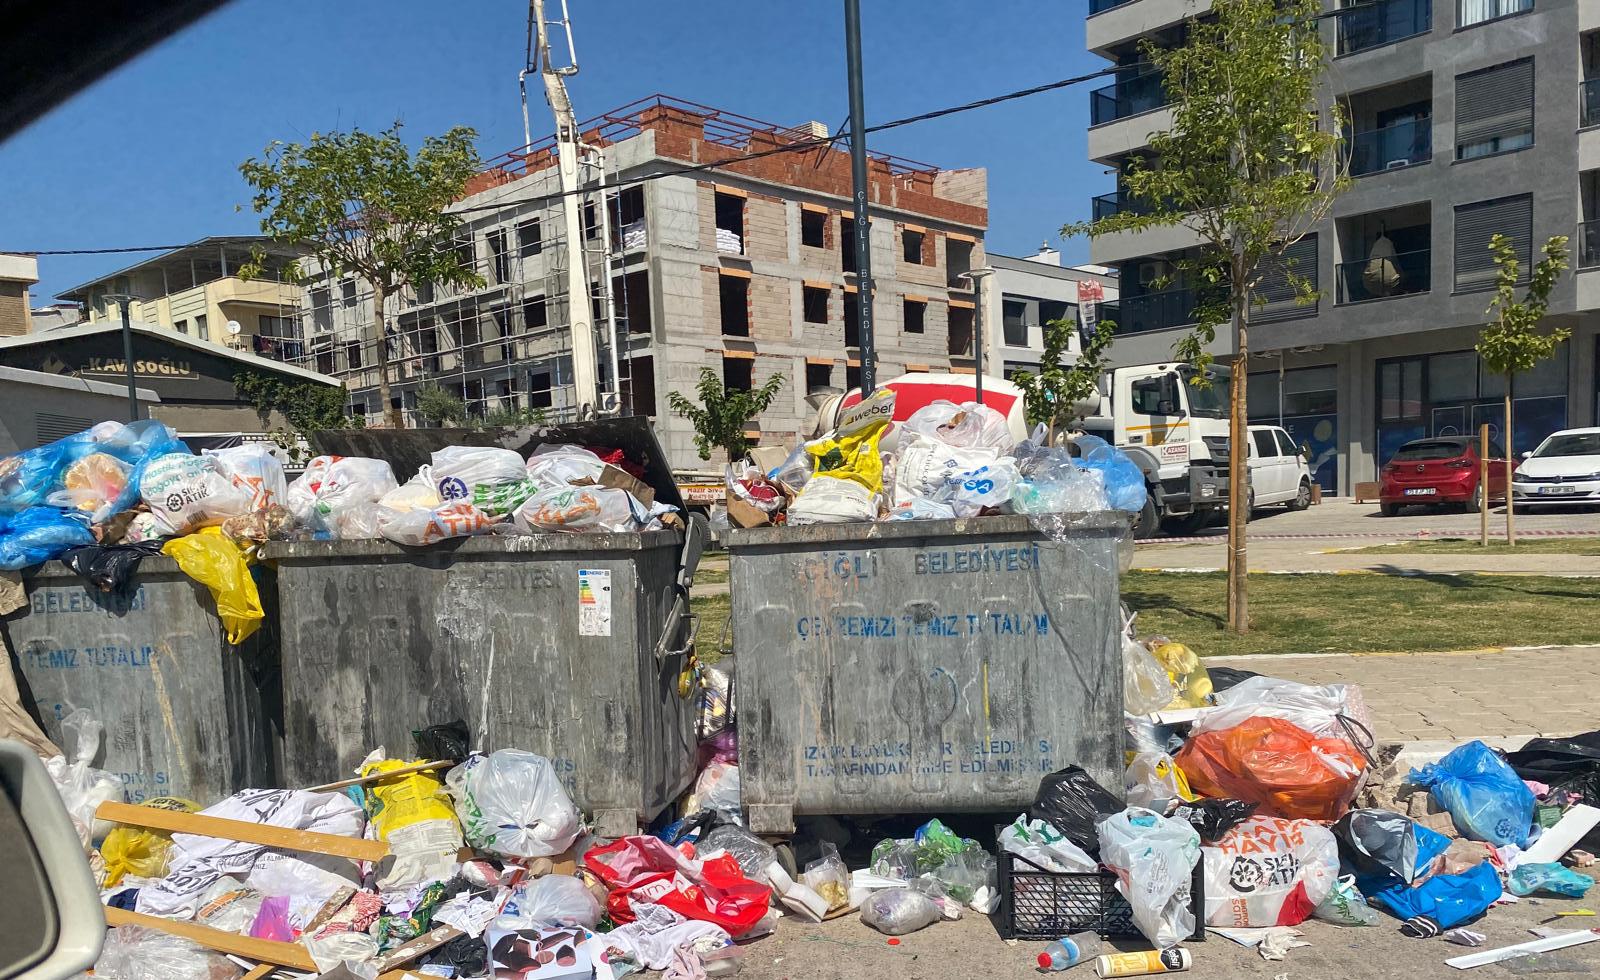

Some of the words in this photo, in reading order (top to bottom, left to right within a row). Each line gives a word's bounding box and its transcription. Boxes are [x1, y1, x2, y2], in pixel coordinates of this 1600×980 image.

[854, 402, 894, 422] weber
[185, 488, 210, 505] ATIK
[914, 542, 1039, 574] BELEDİYESİ
